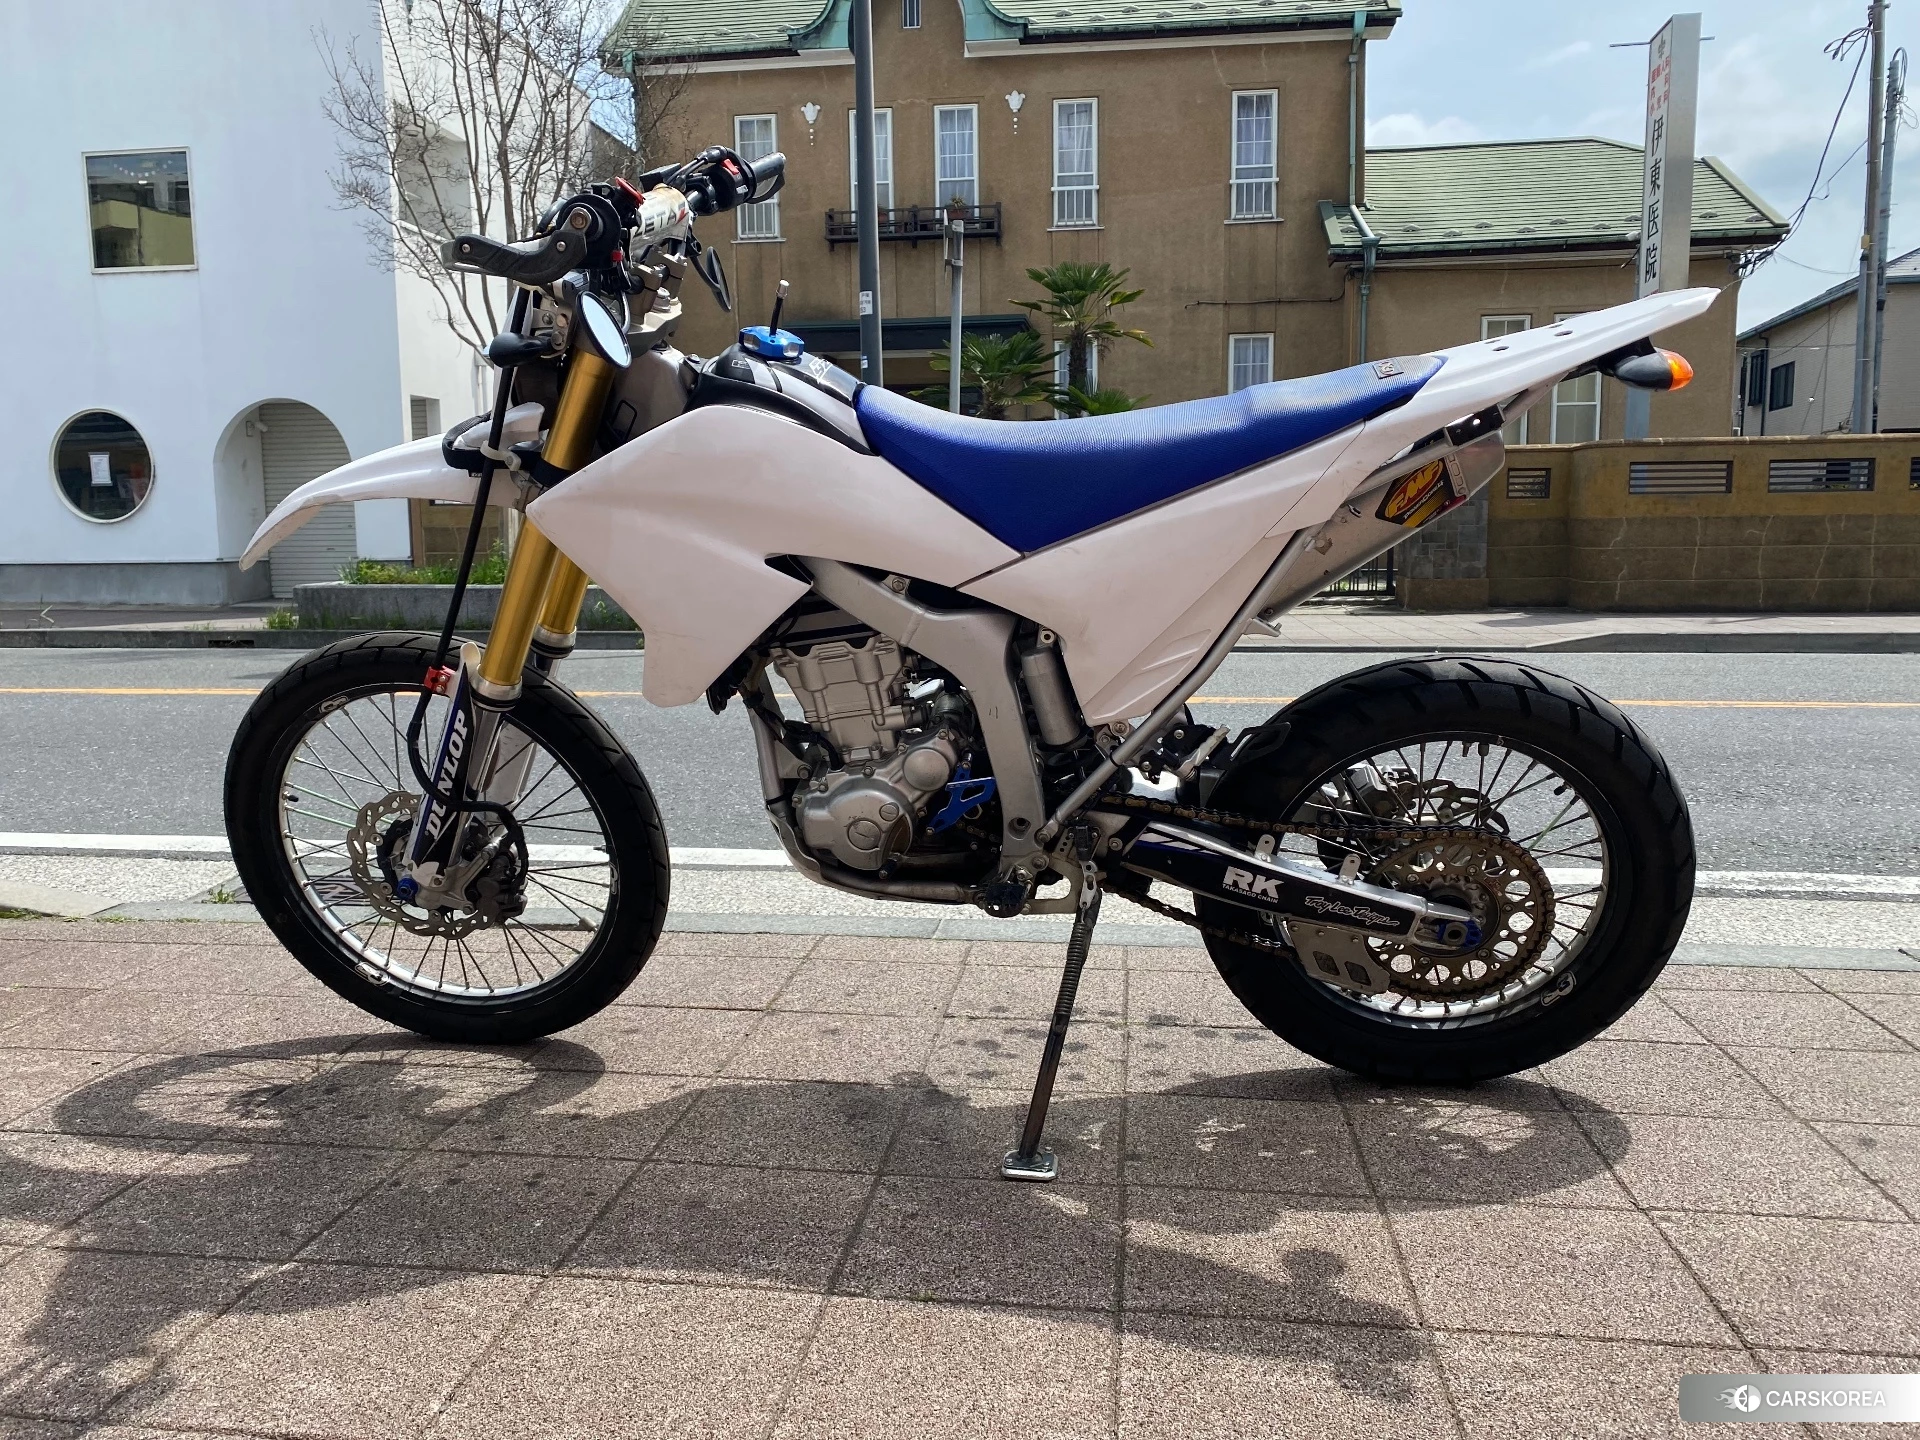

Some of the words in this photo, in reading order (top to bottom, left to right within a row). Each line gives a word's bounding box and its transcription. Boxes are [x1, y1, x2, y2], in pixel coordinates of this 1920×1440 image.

[1644, 115, 1664, 284] 伊東医院
[426, 709, 468, 840] DUNLOP
[1222, 883, 1257, 898] TAKASAGO
[1257, 894, 1279, 904] CHAIN
[1223, 866, 1285, 899] RK
